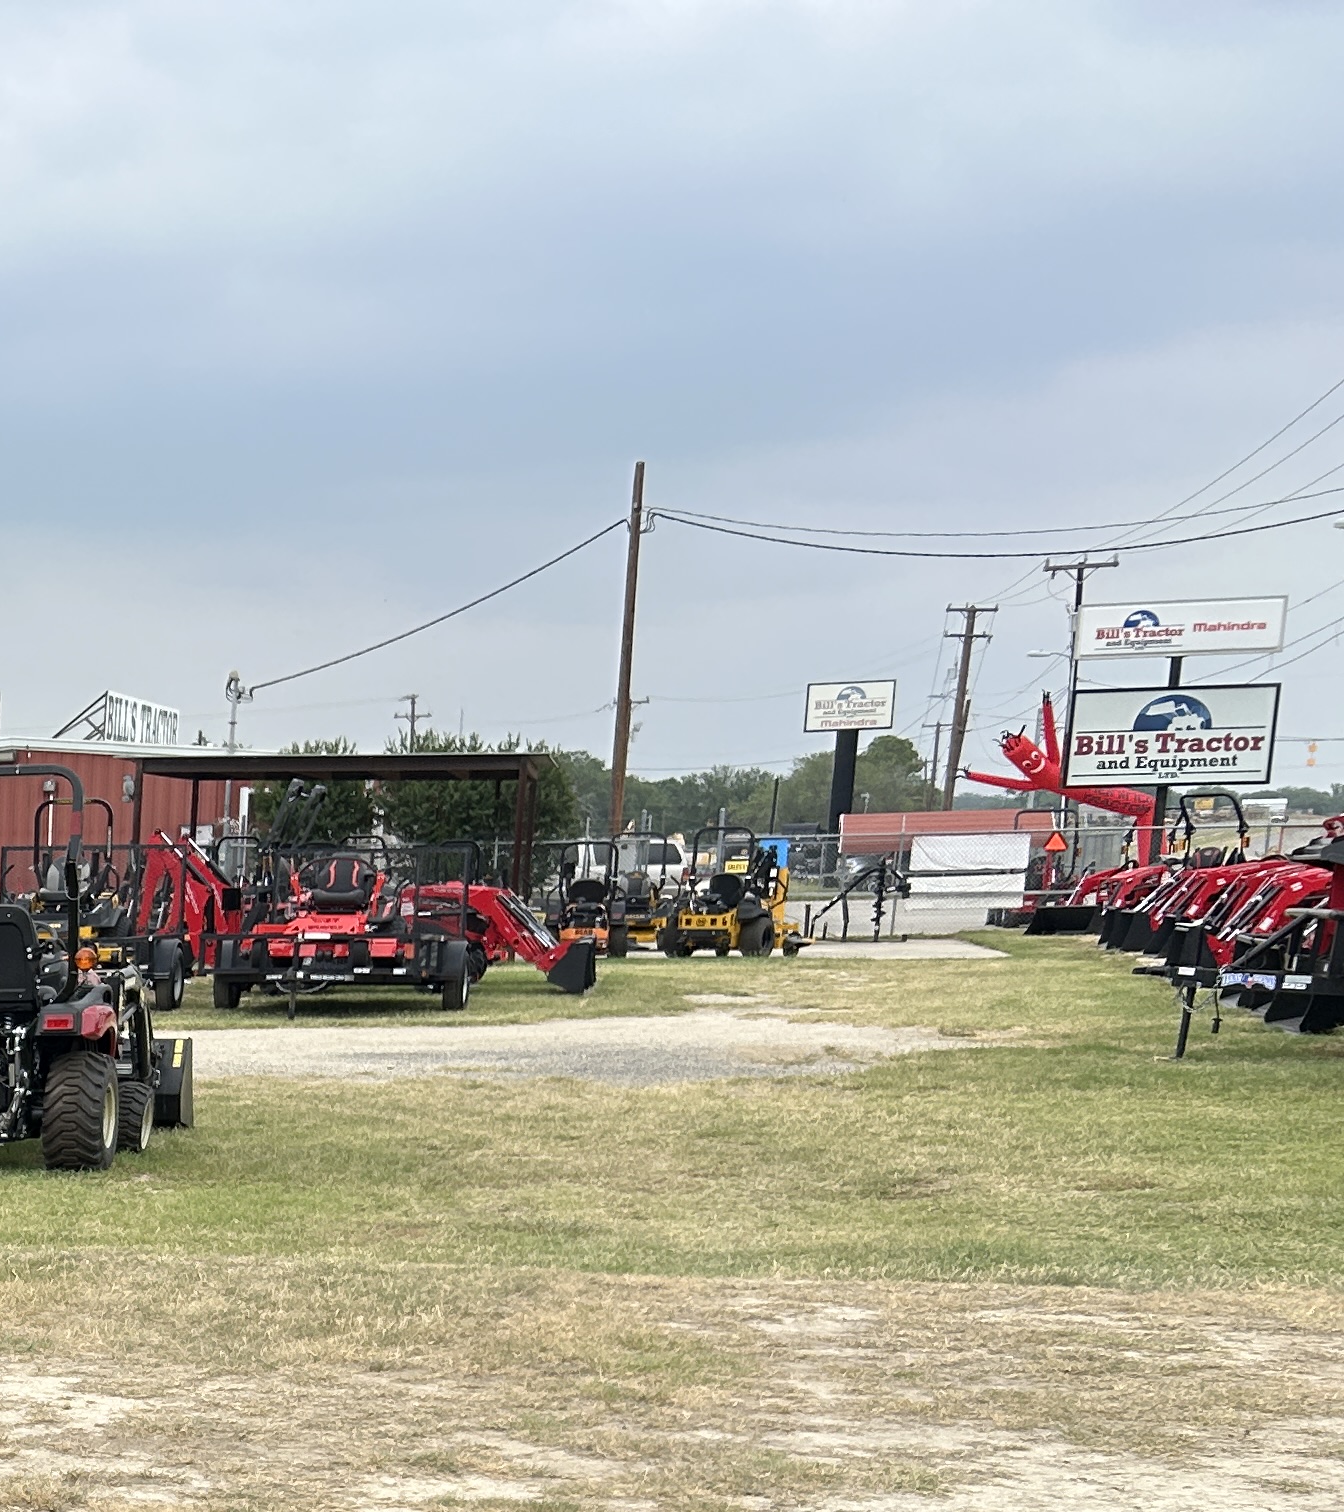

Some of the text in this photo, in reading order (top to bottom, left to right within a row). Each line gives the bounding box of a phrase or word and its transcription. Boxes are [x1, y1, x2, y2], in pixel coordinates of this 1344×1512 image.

[1095, 624, 1185, 640] Bill's Tractor
[1106, 638, 1122, 647] and
[1124, 637, 1172, 648] Equipment
[814, 699, 887, 710] Bill's Tractor
[140, 704, 178, 745] TRACTOR
[1074, 732, 1265, 756] Bill's Tractor
[1096, 754, 1238, 772] and Equipment
